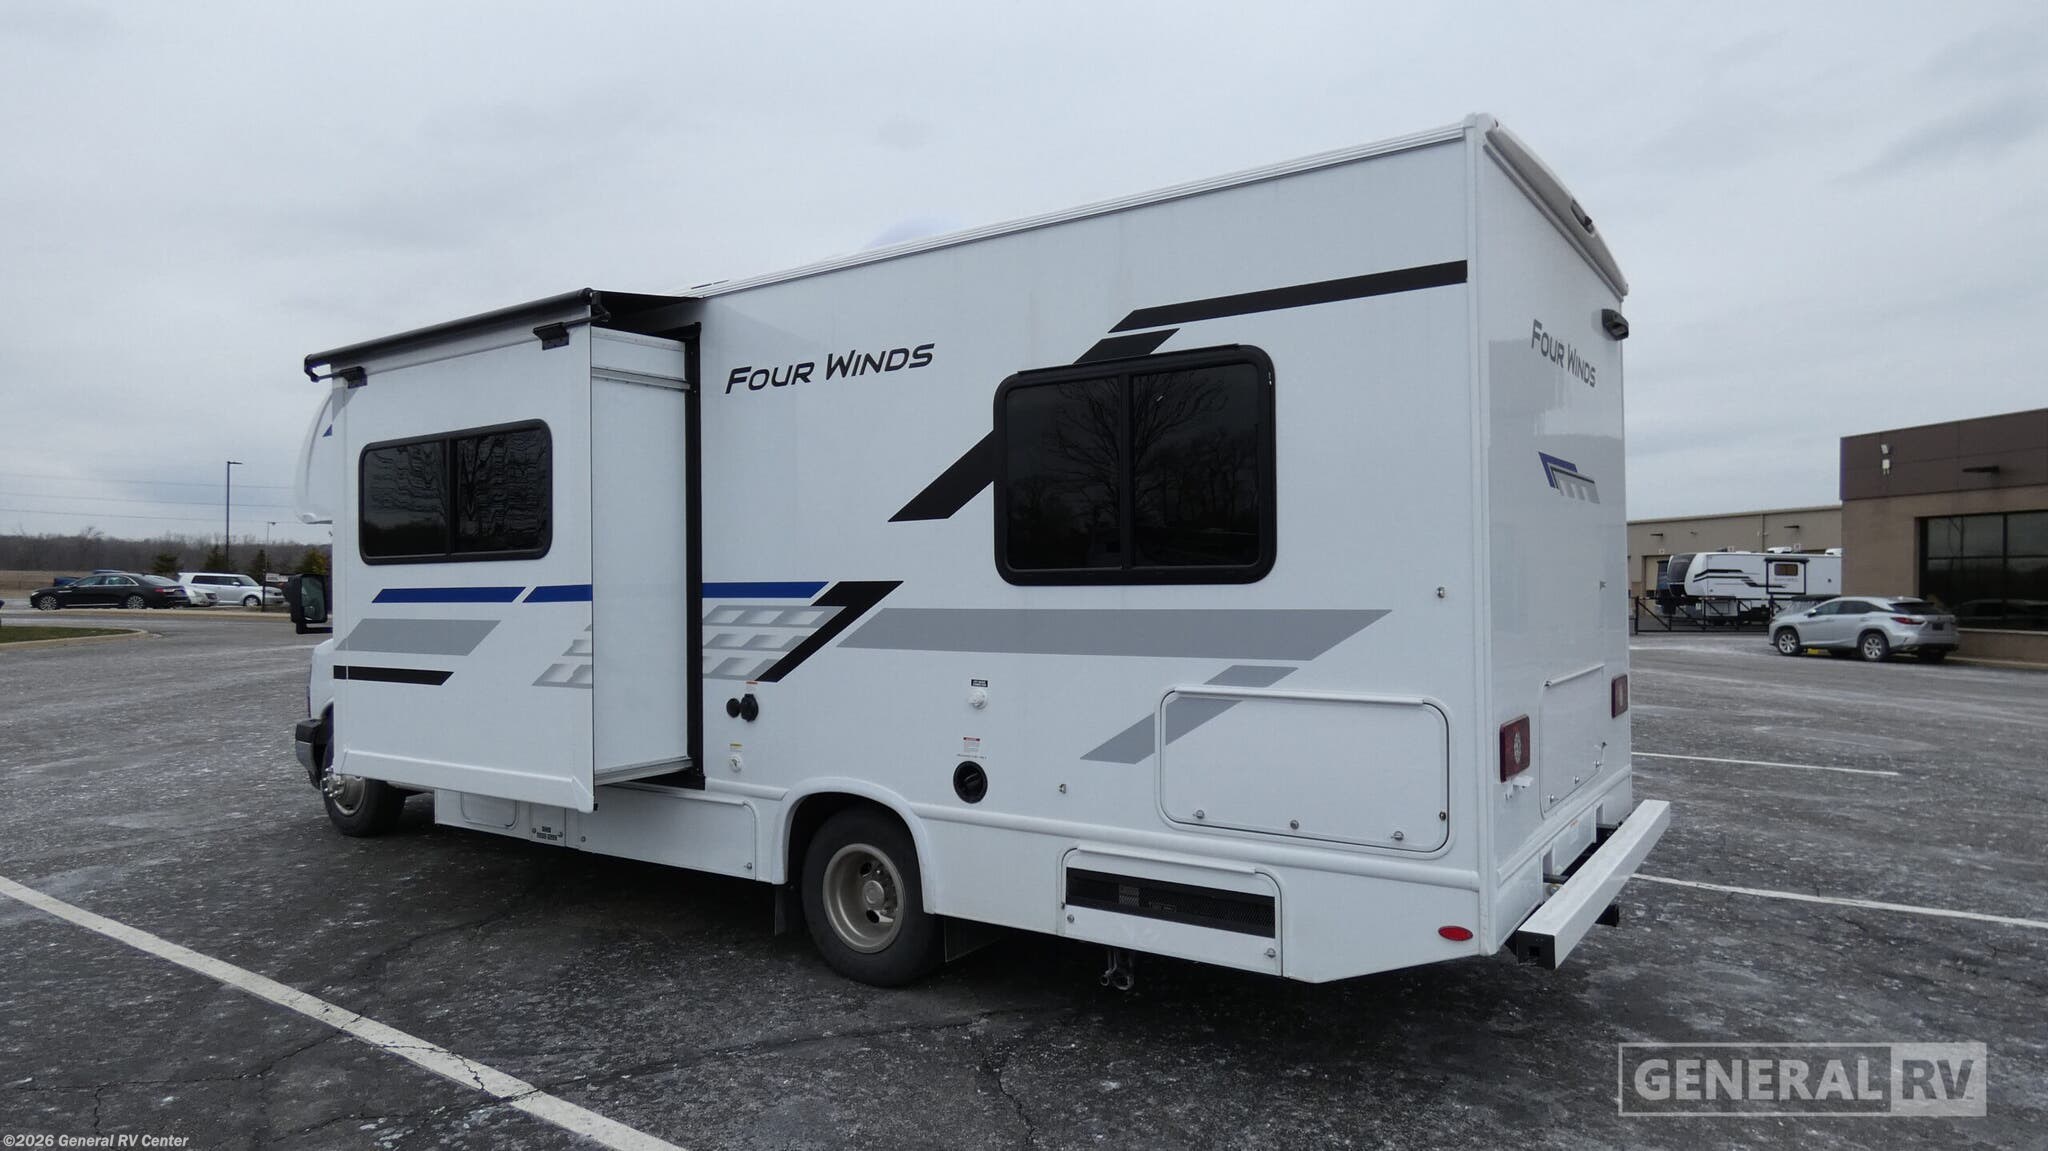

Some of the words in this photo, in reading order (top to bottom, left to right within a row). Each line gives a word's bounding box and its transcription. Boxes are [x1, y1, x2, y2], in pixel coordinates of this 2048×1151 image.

[725, 361, 815, 394] FOUR
[825, 343, 935, 380] WINDS
[1532, 318, 1564, 368] FOUR
[1567, 344, 1596, 388] WINDS
